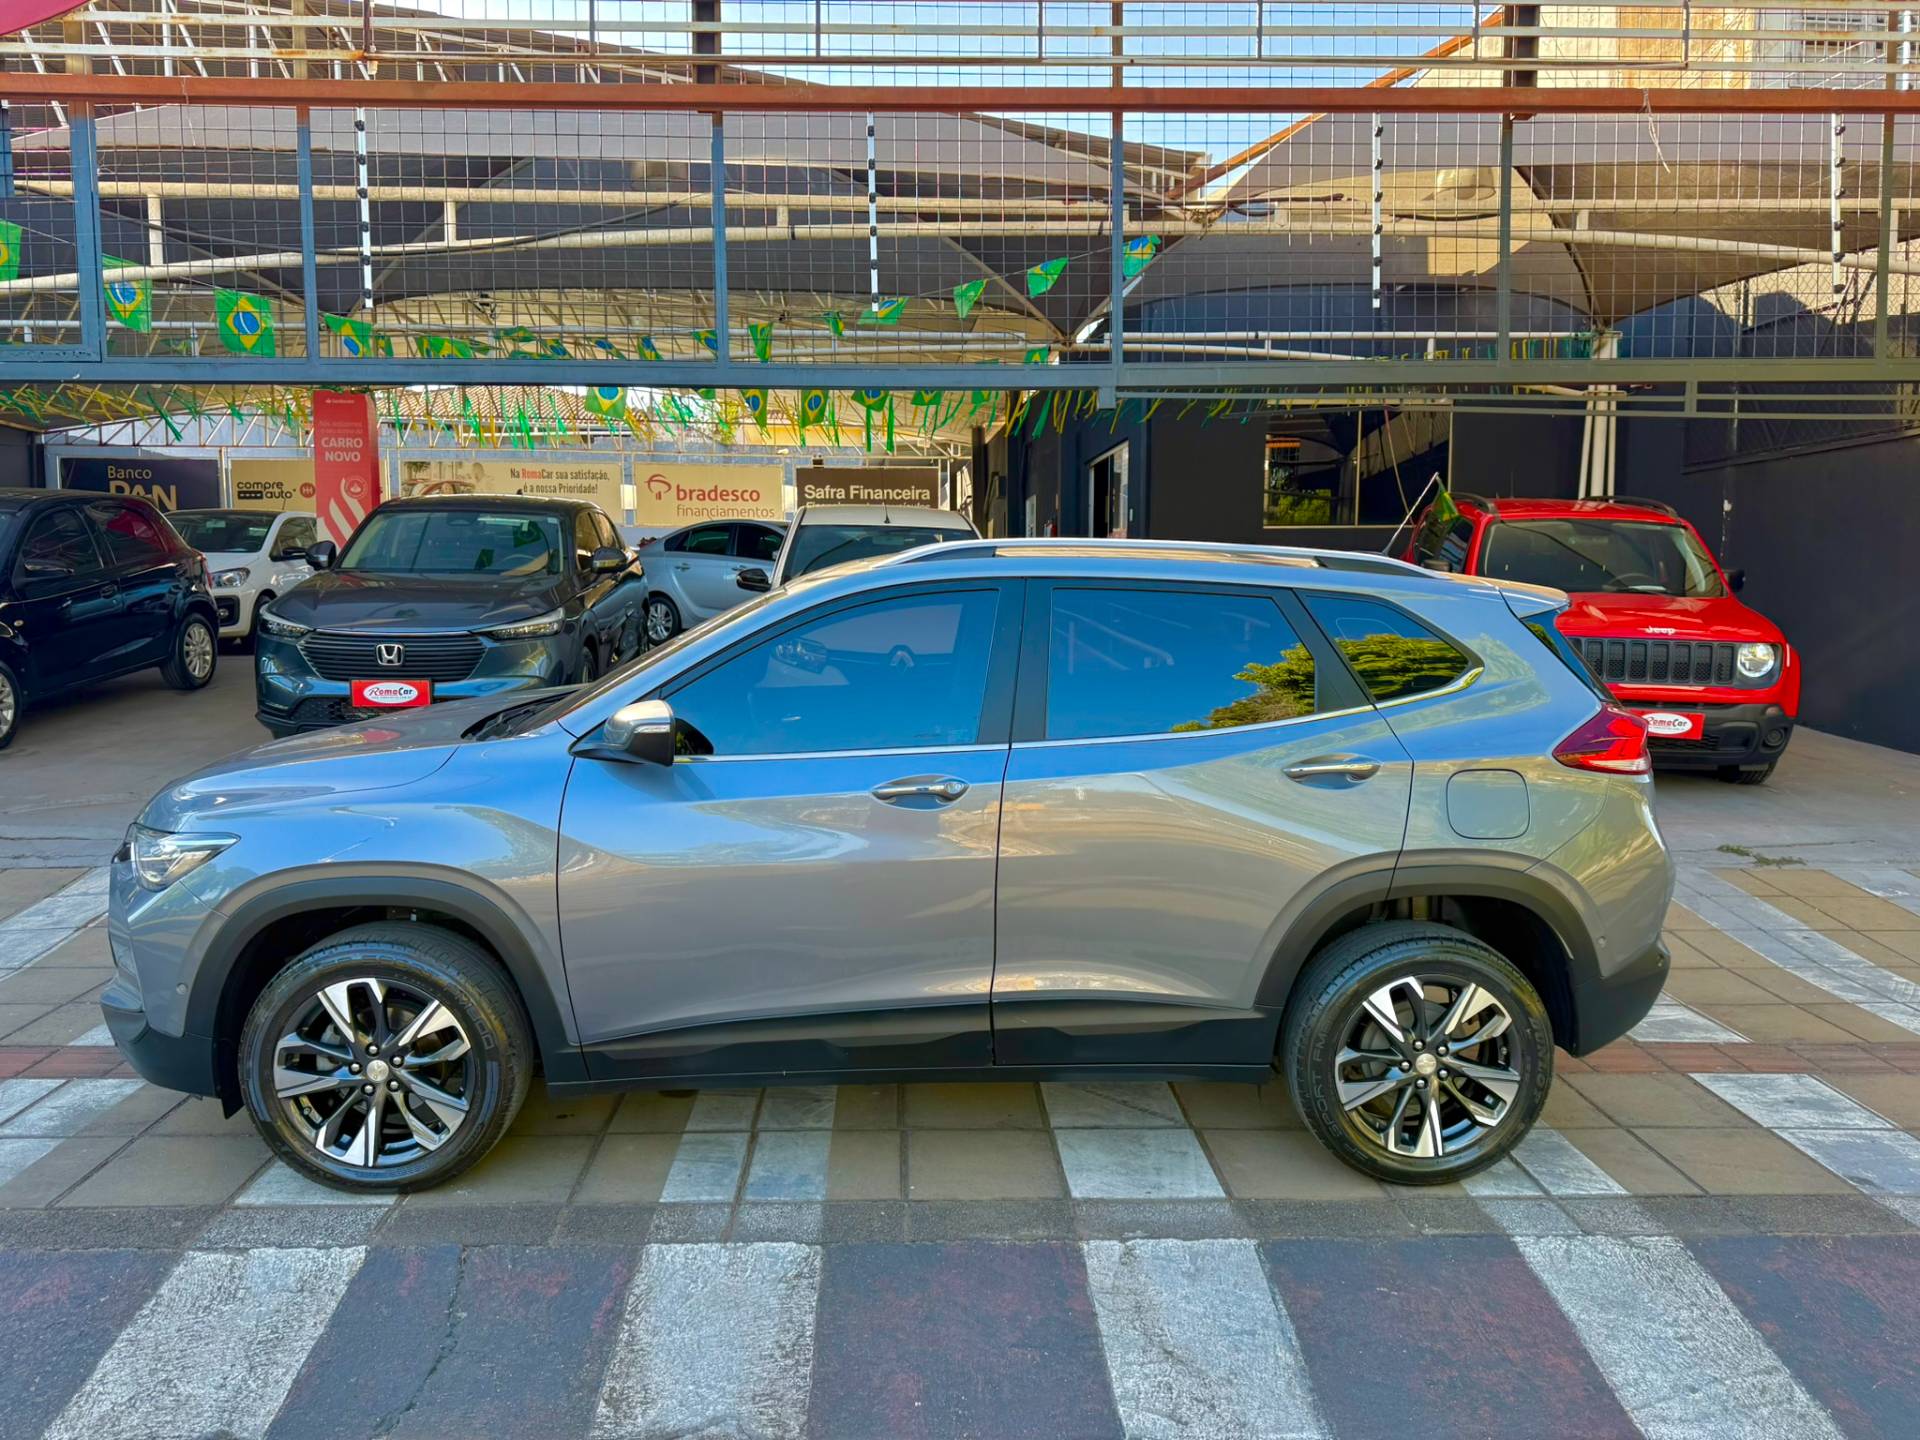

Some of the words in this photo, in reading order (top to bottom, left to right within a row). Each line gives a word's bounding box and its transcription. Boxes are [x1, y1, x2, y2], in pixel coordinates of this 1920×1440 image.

[321, 437, 363, 448] CARRO
[325, 451, 361, 462] NOVO
[107, 465, 152, 479] Banco
[510, 468, 520, 479] Na
[522, 468, 554, 480] RomaCar
[555, 471, 569, 480] sua
[570, 469, 610, 481] satisfação,
[237, 481, 284, 491] compre
[536, 485, 557, 494] nossa
[559, 483, 598, 495] Prioridade!
[804, 484, 846, 500] Safra
[849, 485, 931, 500] Financeira
[265, 489, 293, 499] auto
[676, 483, 761, 502] bradesco
[676, 504, 776, 520] financiamentos
[1645, 625, 1677, 635] Jeep
